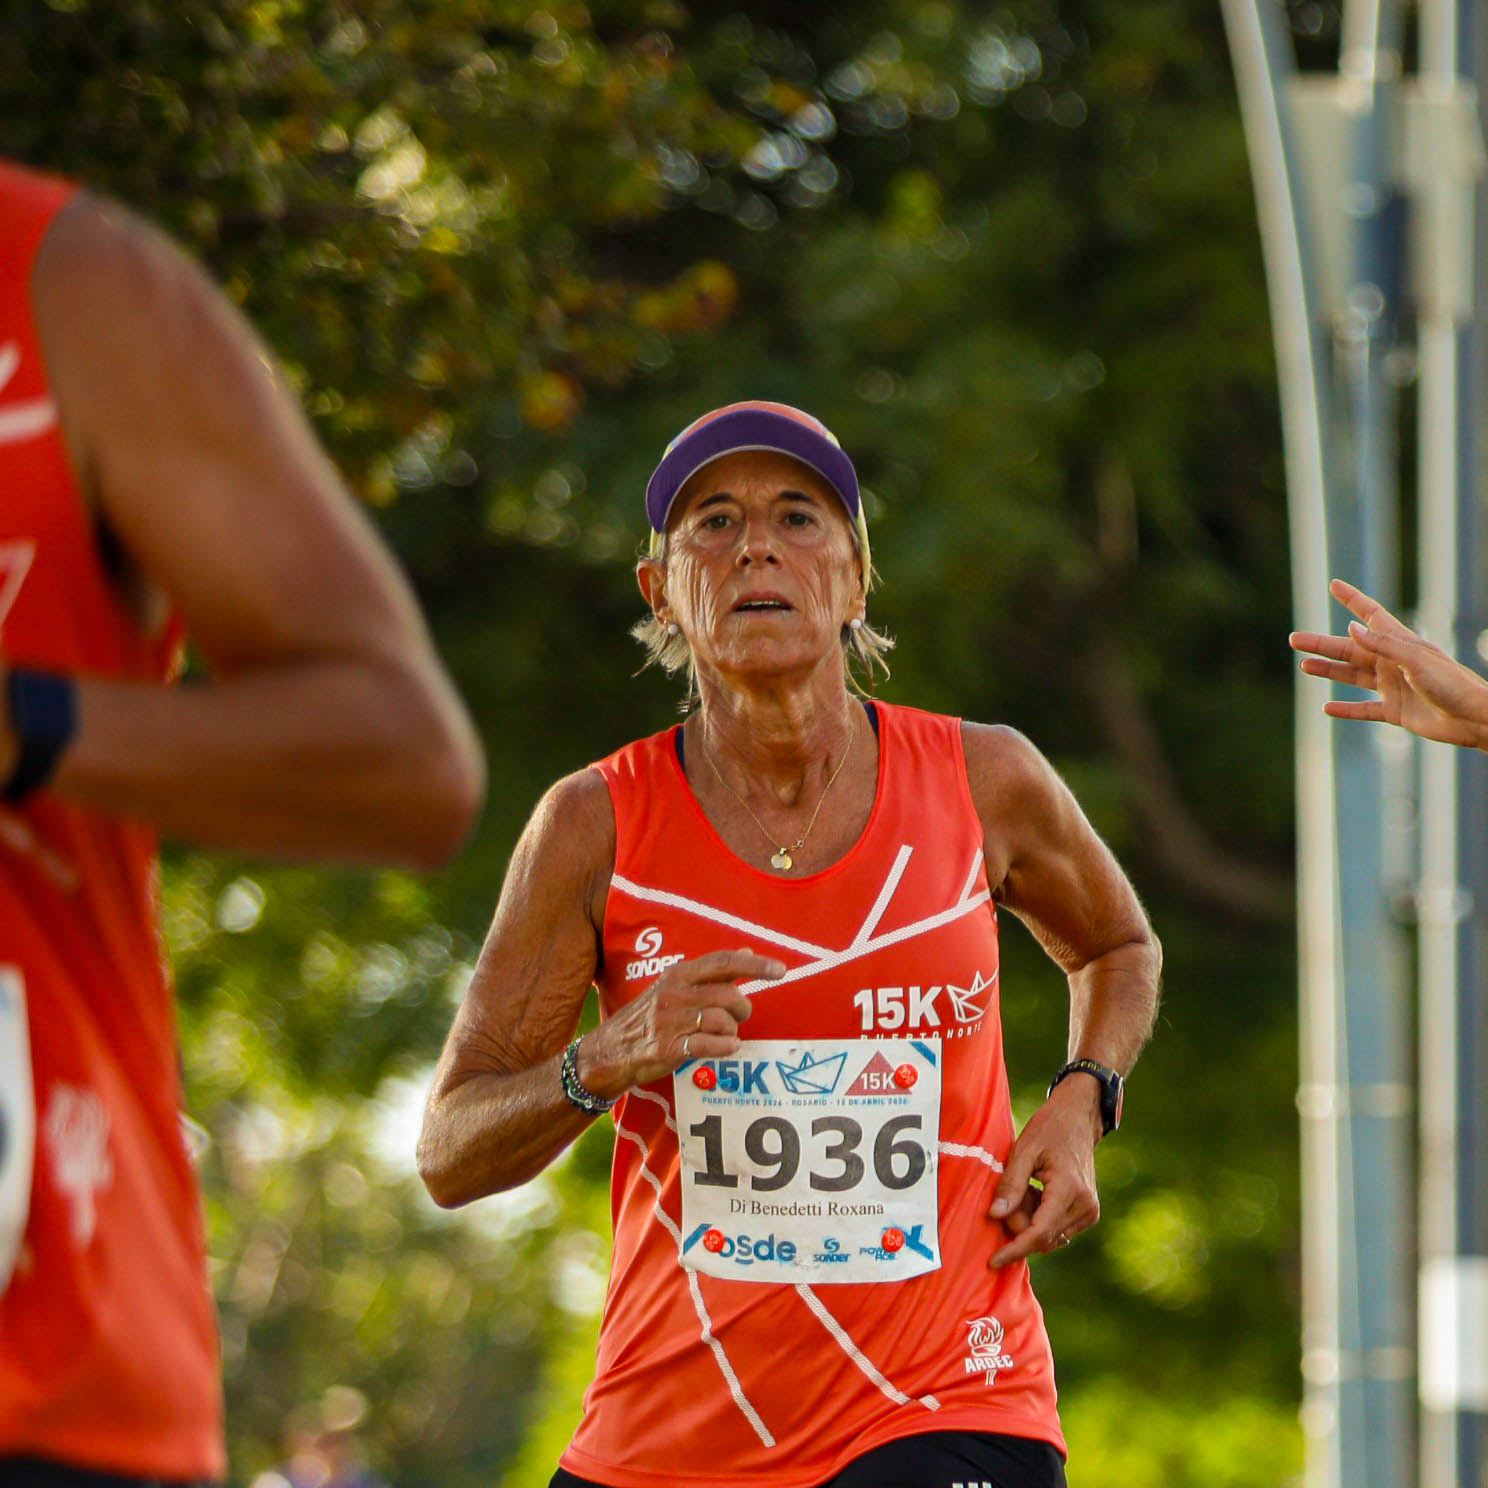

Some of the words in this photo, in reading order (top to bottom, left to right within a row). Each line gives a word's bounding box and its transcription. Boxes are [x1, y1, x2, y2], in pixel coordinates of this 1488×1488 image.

[854, 986, 943, 1030] 15K
[861, 1072, 896, 1090] 15K
[690, 1114, 927, 1192] 1936
[730, 1198, 746, 1214] Di
[751, 1200, 822, 1216] Benedetti
[828, 1202, 884, 1216] Roxana
